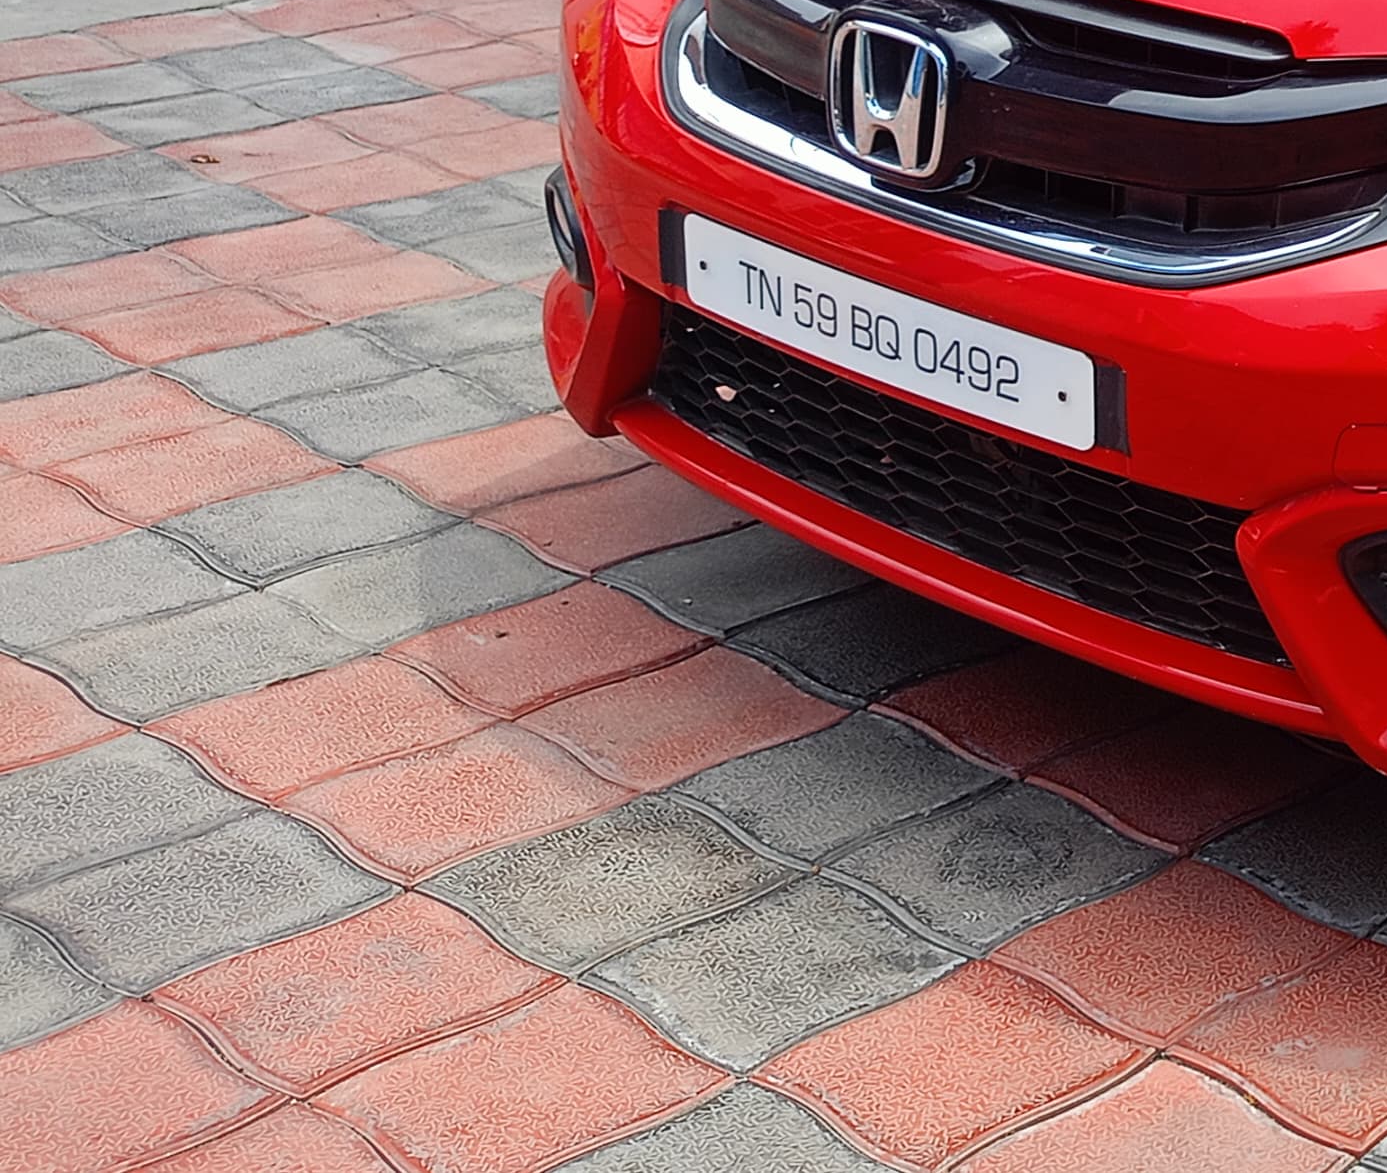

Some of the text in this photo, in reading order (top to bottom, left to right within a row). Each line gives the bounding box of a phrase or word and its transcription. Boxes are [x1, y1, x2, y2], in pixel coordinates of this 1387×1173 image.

[739, 260, 1019, 403] TN 59 BQ 0492
